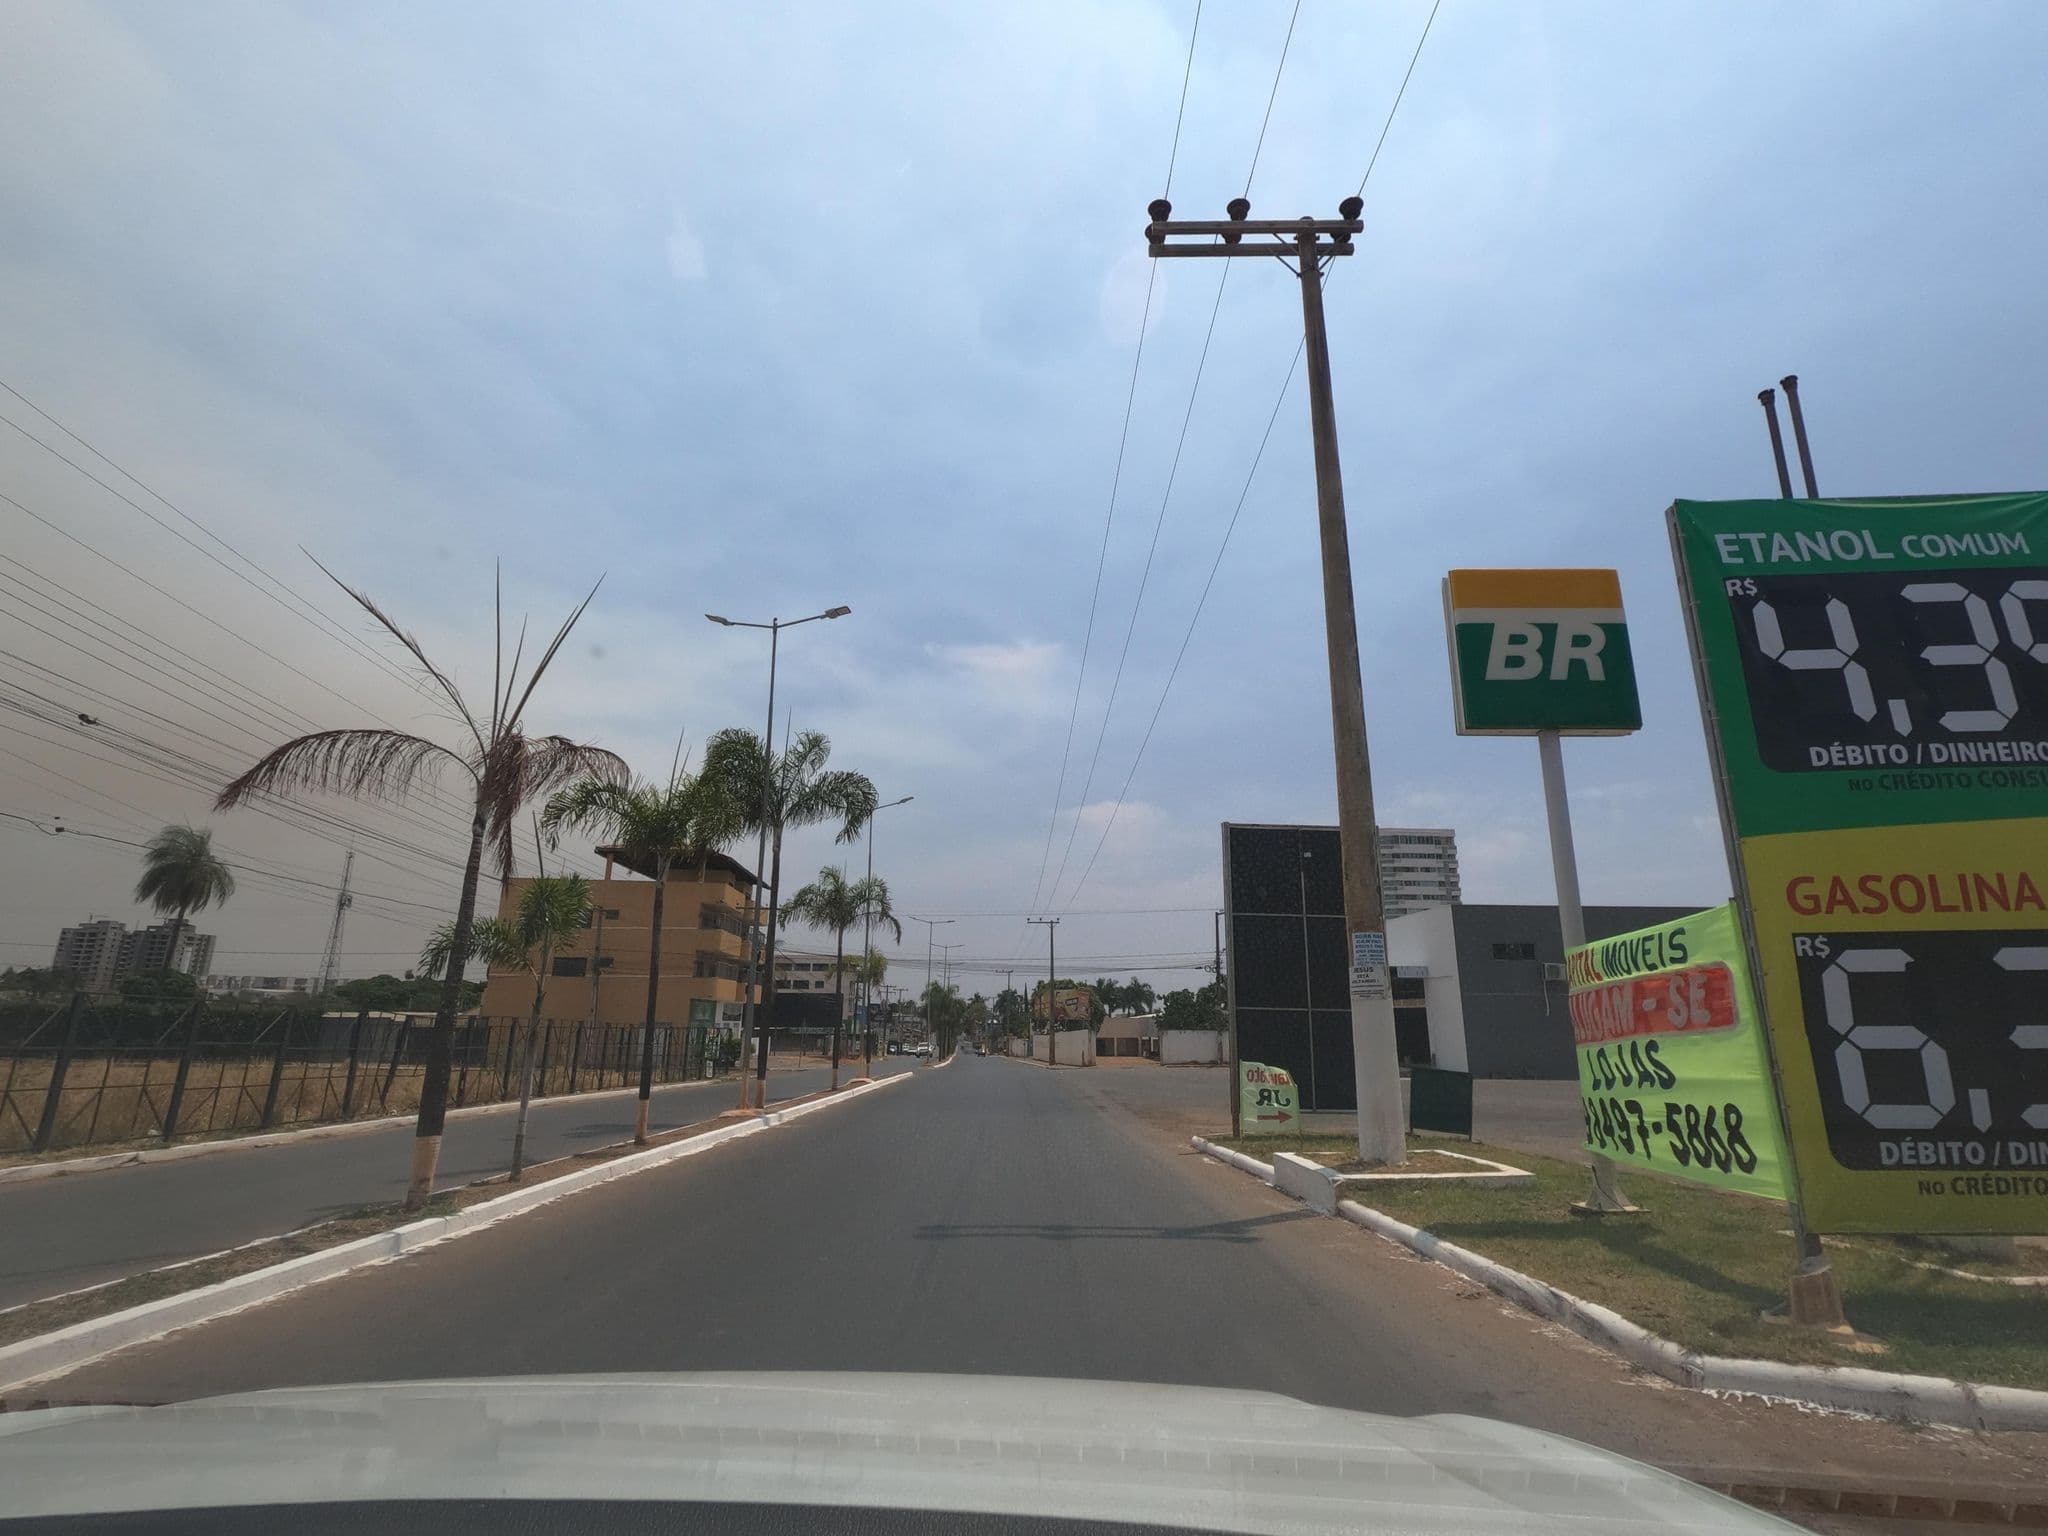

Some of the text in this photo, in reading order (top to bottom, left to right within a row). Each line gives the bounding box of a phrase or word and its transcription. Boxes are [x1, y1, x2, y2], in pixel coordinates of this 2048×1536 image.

[1714, 529, 2032, 565] ETANOL COMUM
[1725, 577, 1758, 598] R$
[1484, 622, 1607, 681] BR
[1809, 742, 1909, 767] DÉBITO
[1879, 769, 1973, 791] CRÉDITO
[1785, 872, 2047, 916] GASOLINA
[1601, 927, 1689, 979] IMOVEIS
[1795, 935, 1830, 959] R$
[1587, 1039, 1676, 1091] LOJAS
[1880, 1137, 1985, 1166] DÉBITO
[1951, 1173, 2048, 1196] CRÉDITO
